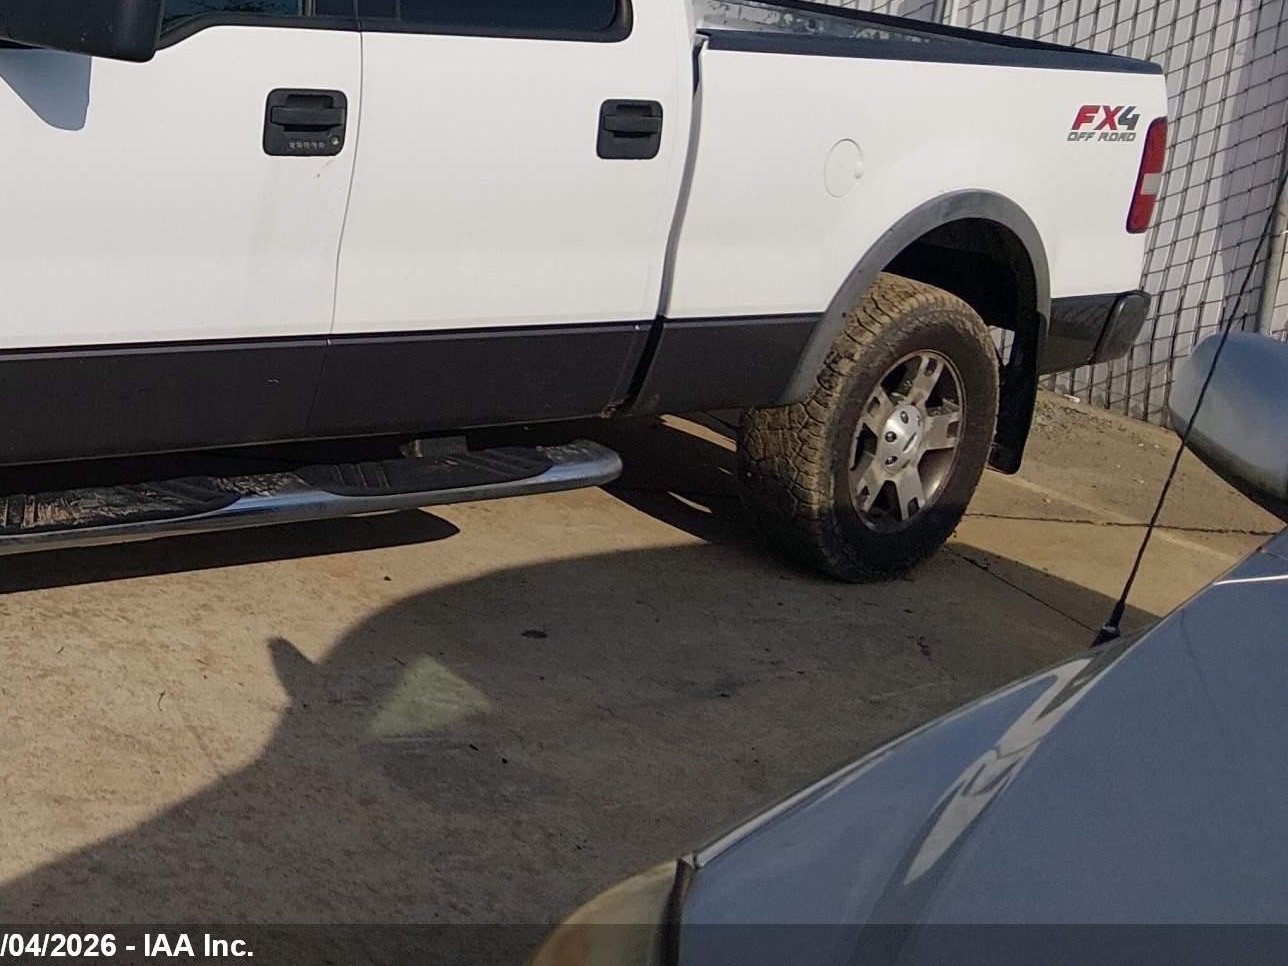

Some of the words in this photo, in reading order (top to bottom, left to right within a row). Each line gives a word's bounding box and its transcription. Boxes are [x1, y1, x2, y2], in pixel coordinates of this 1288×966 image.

[1070, 105, 1141, 131] FX4
[1066, 131, 1096, 142] OFF
[1097, 131, 1137, 143] ROAD
